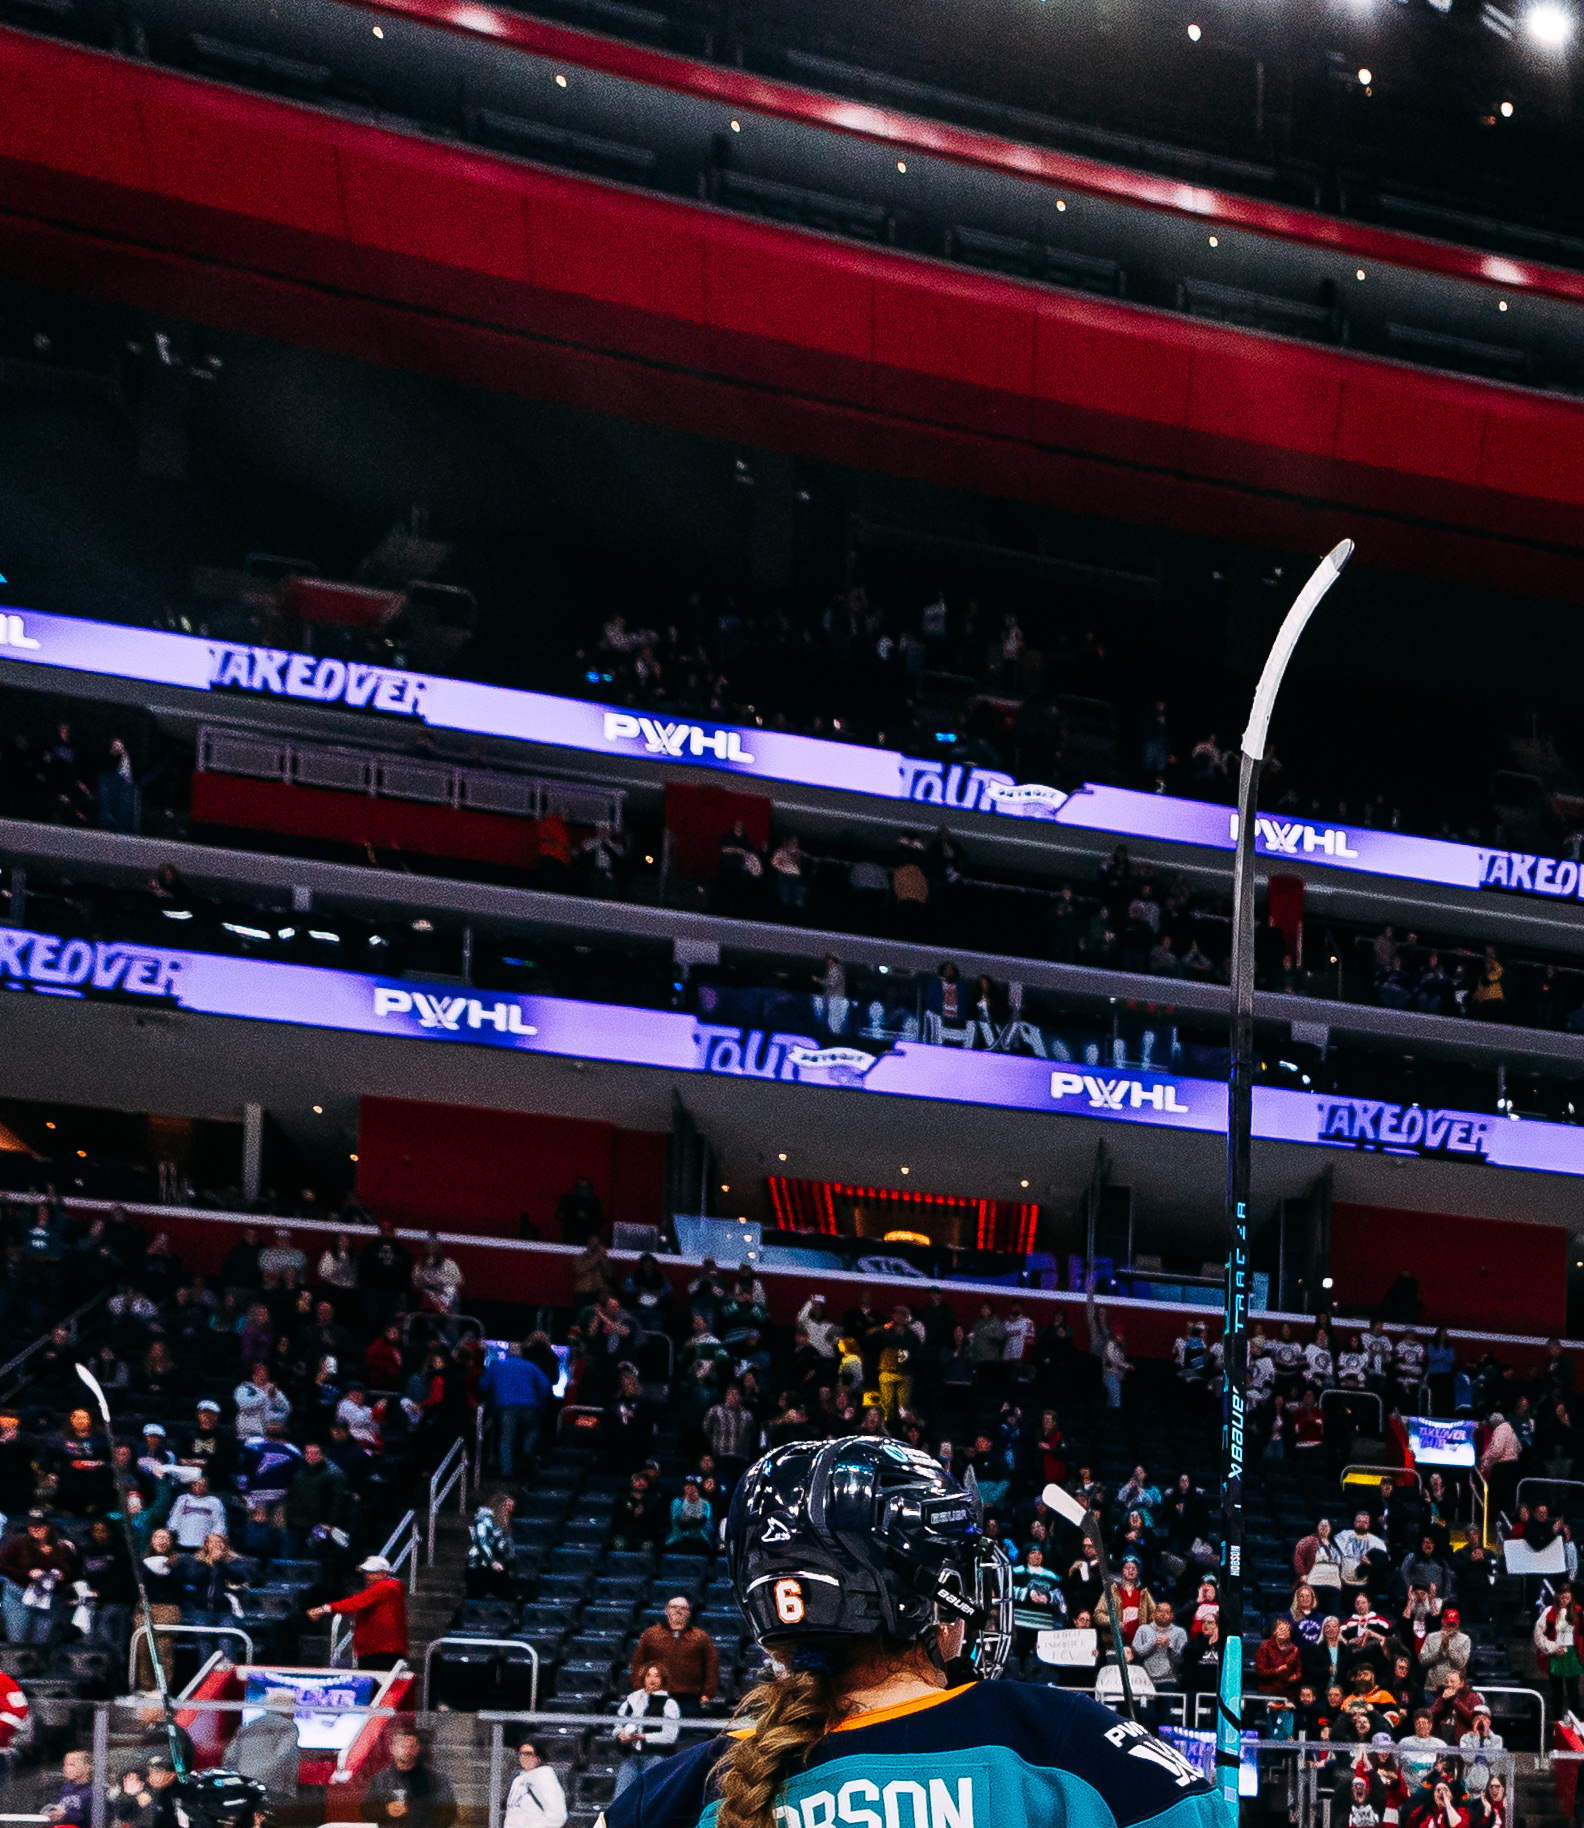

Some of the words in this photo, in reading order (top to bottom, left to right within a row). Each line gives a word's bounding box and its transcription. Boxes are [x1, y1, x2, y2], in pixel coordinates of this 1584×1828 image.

[603, 712, 755, 764] PWHL
[374, 987, 537, 1037] PWHL
[1050, 1071, 1189, 1113] PWHL
[774, 1578, 804, 1624] 6
[936, 1588, 975, 1616] BAUER
